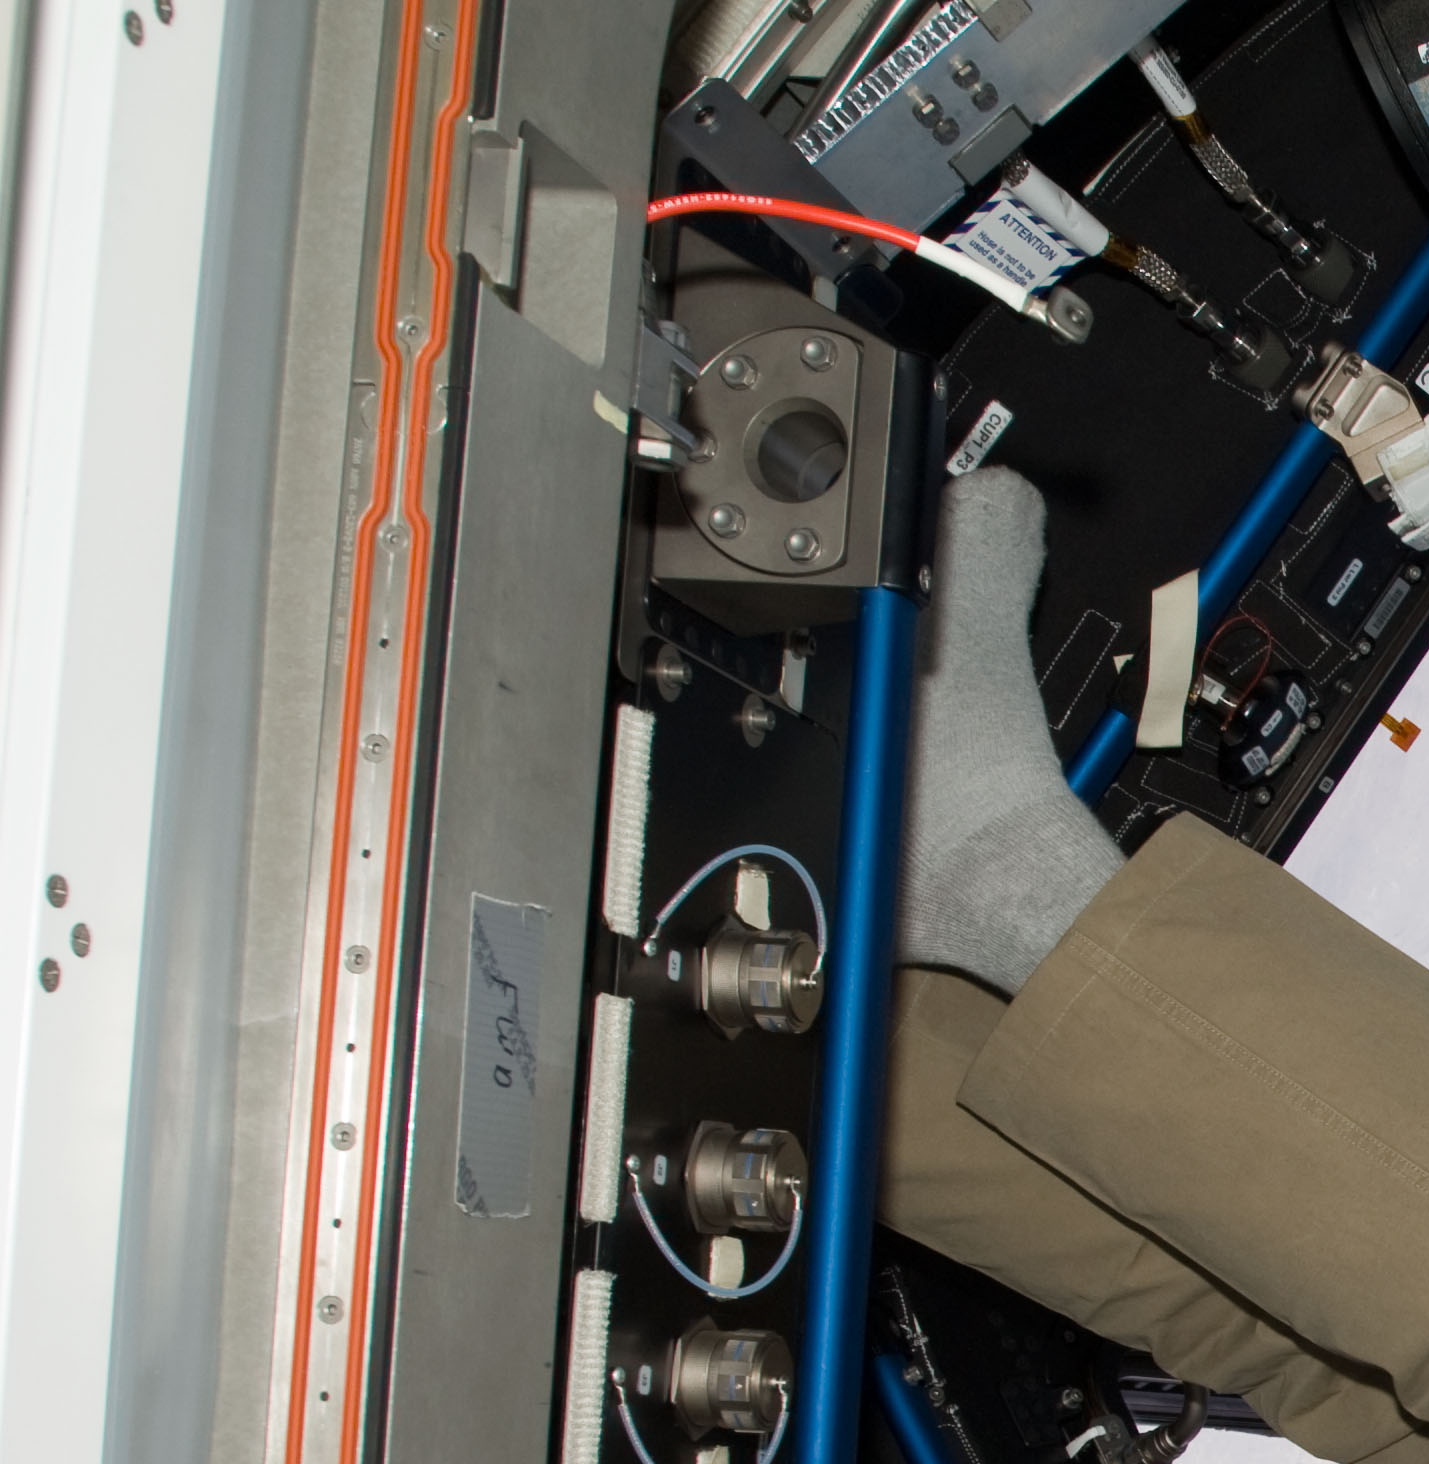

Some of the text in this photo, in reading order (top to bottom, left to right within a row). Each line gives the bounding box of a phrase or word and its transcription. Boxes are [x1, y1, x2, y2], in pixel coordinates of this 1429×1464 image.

[978, 230, 1036, 280] Hose is not to be
[999, 213, 1058, 262] ATTENTION
[969, 239, 990, 257] used
[987, 253, 998, 265] as
[1002, 263, 1028, 288] handle
[956, 413, 1002, 471] CUP1_P3
